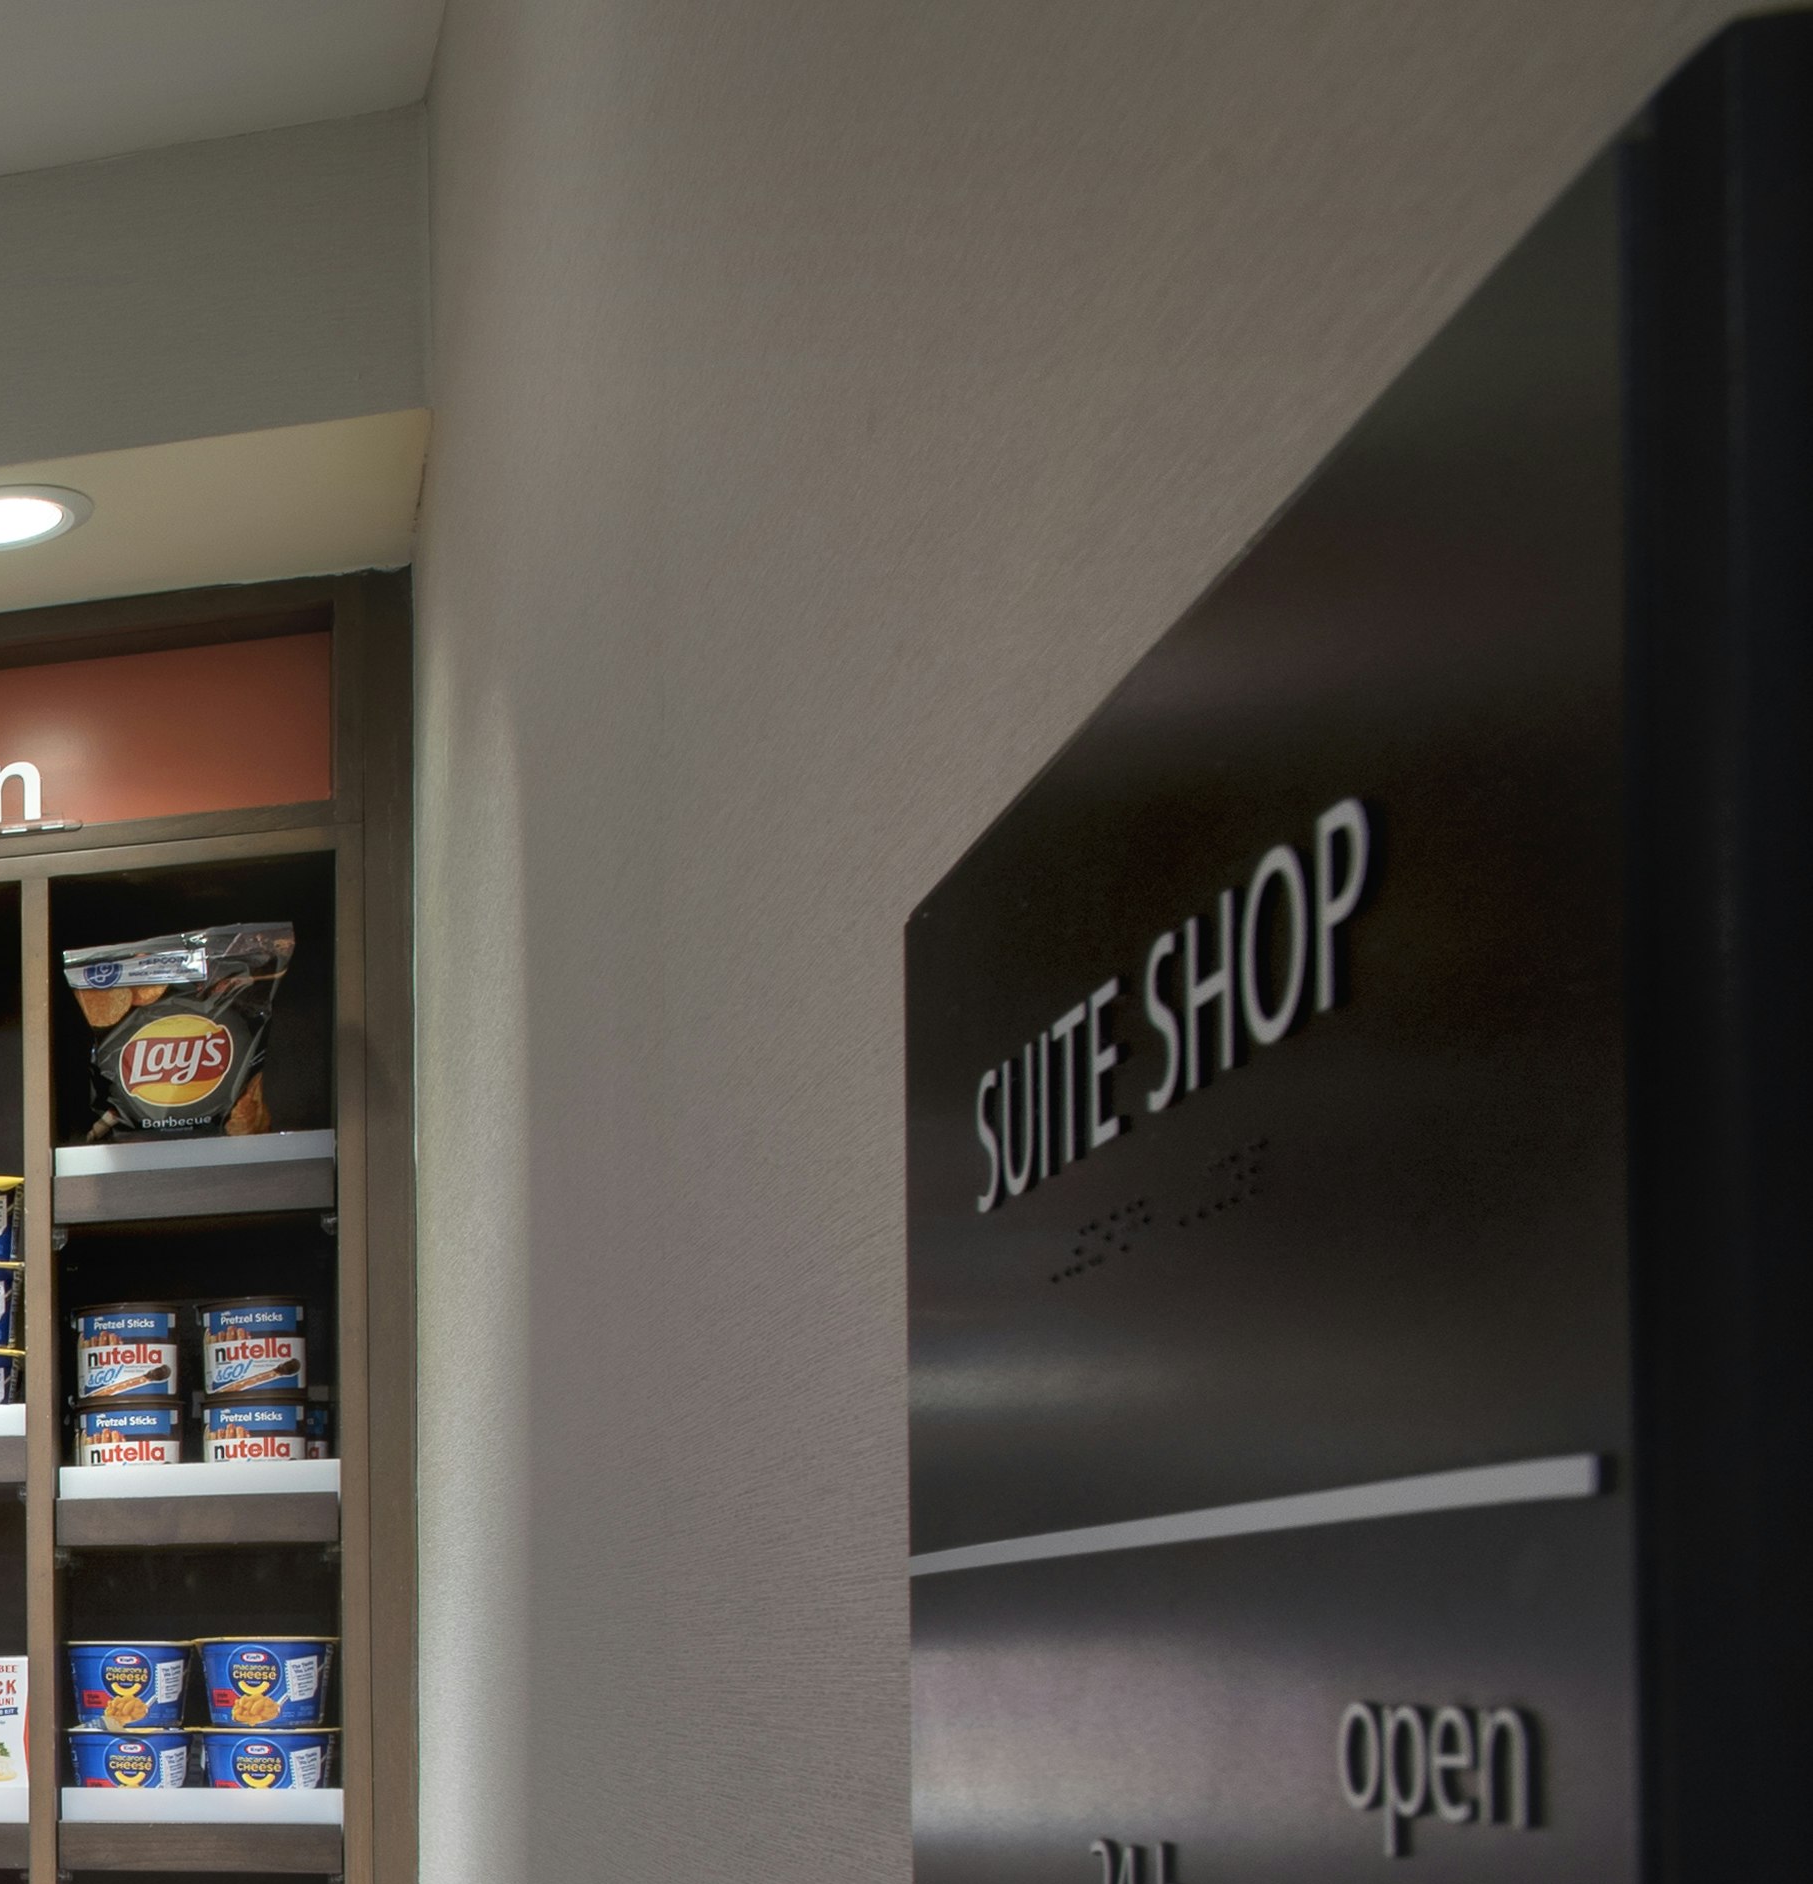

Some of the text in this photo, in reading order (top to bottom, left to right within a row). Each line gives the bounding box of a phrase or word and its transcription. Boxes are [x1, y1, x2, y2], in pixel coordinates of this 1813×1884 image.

[977, 798, 1369, 1213] SUITE SHOP
[129, 1031, 225, 1084] Lay's
[142, 1115, 212, 1129] Barbecue
[93, 1318, 156, 1331] Pretzel Sticks
[220, 1312, 284, 1326] Pretzel Sticks
[87, 1344, 163, 1368] nutella
[215, 1337, 292, 1363] nutella
[90, 1440, 165, 1464] nutella
[214, 1436, 291, 1463] nutella
[1339, 1702, 1530, 1858] open
